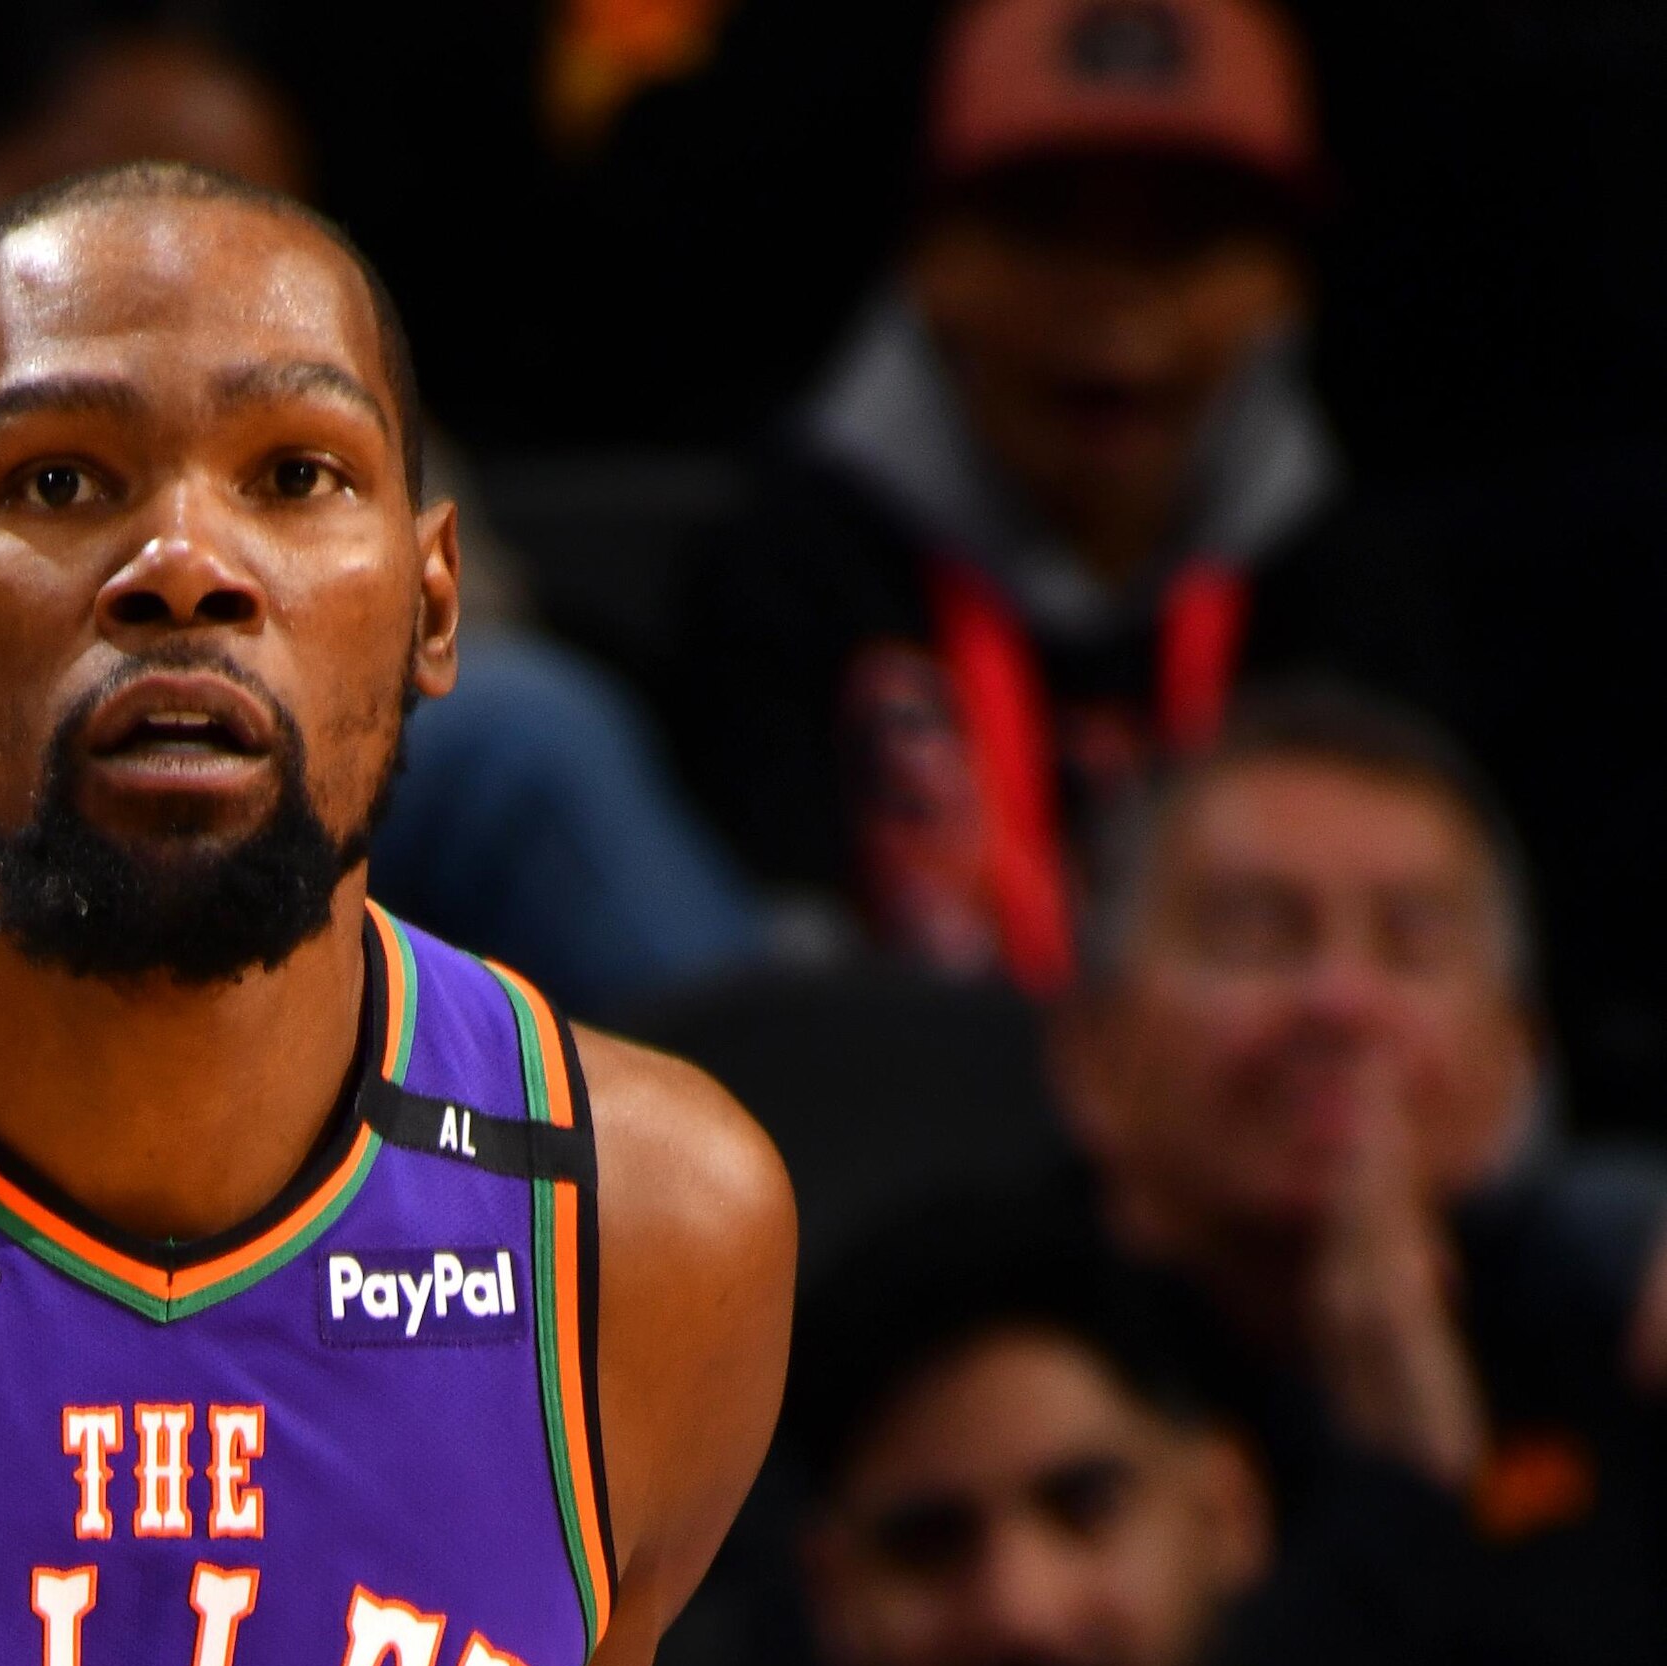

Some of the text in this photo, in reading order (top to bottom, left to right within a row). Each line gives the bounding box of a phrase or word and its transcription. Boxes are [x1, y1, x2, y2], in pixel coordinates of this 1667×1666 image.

[439, 1105, 477, 1158] AL
[328, 1250, 517, 1338] PayPal
[63, 1403, 266, 1540] THE
